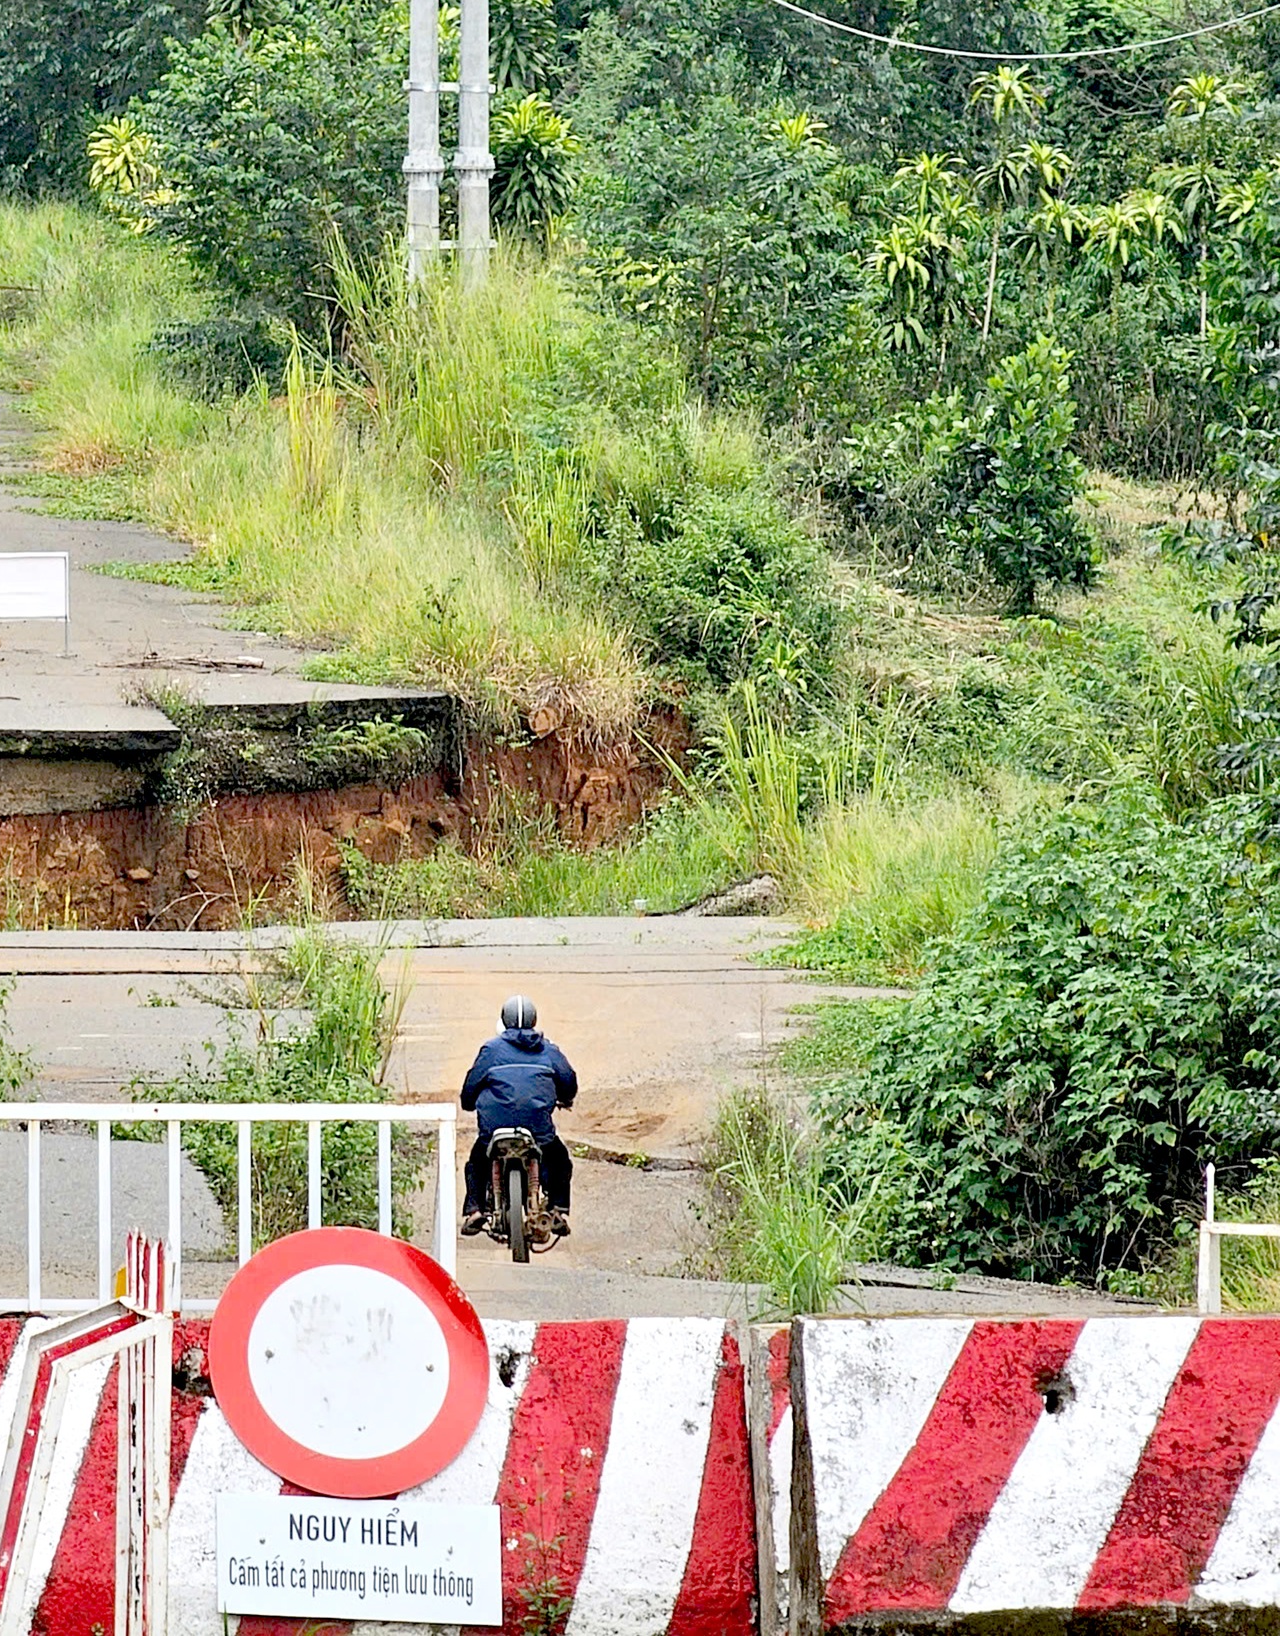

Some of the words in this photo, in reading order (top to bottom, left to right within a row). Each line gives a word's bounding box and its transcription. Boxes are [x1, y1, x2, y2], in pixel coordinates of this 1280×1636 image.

[289, 1513, 352, 1543] NGUY
[360, 1507, 418, 1548] HIỂM
[229, 1556, 260, 1587] Cấm
[264, 1554, 285, 1588] tất
[290, 1558, 307, 1589] cả
[312, 1560, 366, 1600] phương
[372, 1565, 399, 1598] tiện
[404, 1565, 428, 1596] lưu
[432, 1566, 474, 1607] thông
